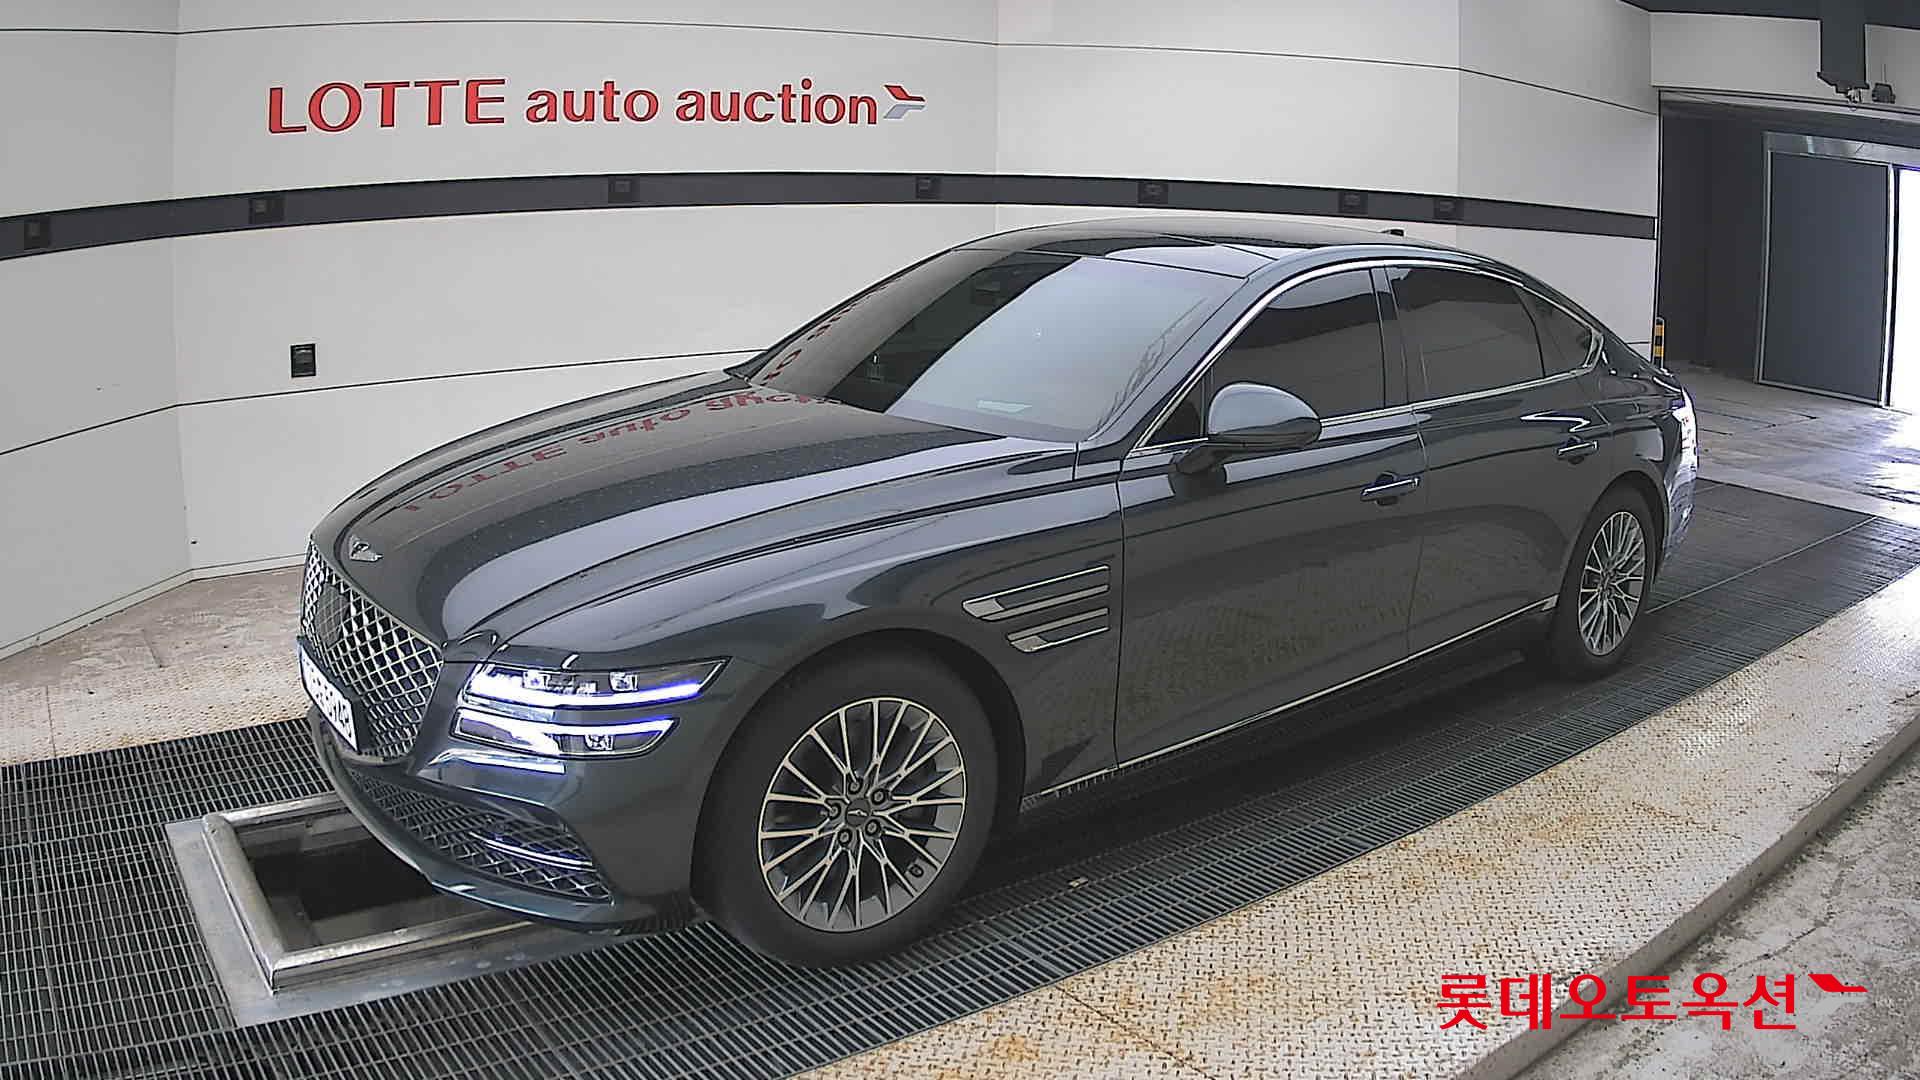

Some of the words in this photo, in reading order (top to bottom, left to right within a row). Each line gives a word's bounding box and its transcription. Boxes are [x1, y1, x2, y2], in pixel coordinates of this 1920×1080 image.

[267, 79, 505, 134] LOTTE
[525, 81, 660, 123] auto
[675, 78, 879, 125] auction
